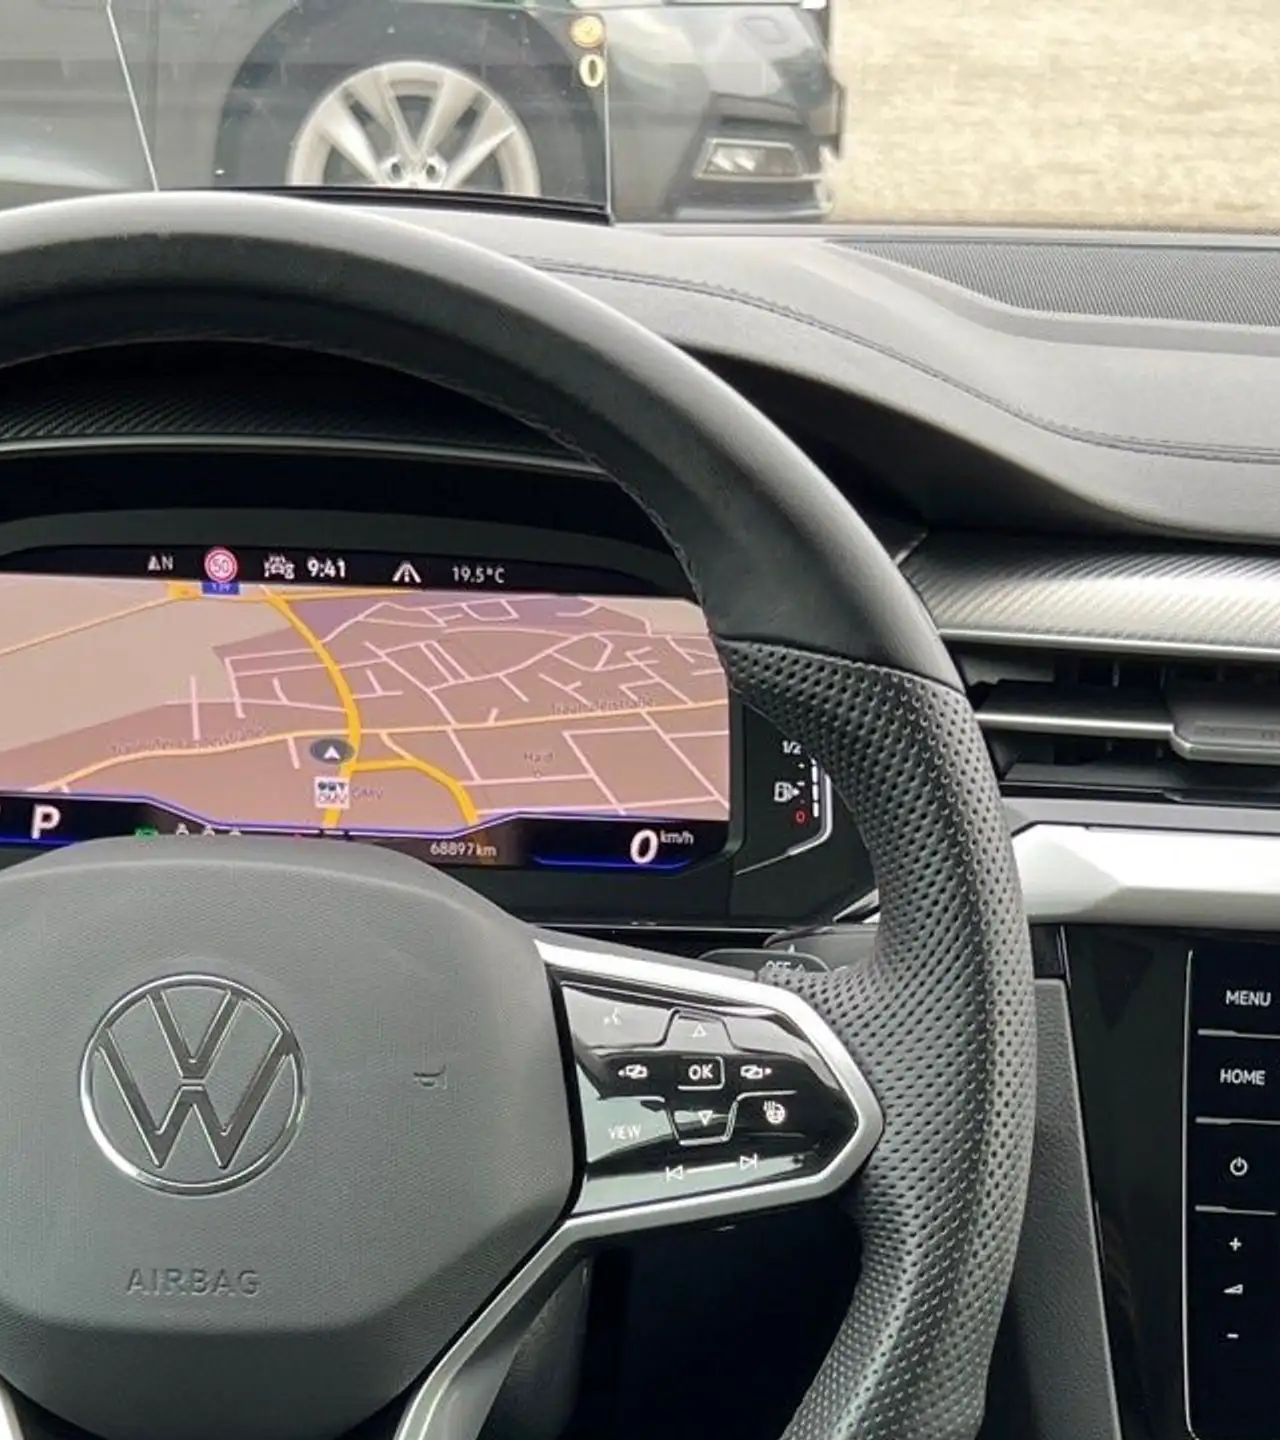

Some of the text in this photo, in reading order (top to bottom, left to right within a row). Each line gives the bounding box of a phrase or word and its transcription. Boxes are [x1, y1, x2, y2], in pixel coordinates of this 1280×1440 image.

[212, 557, 230, 576] 50
[306, 556, 347, 579] 9:41
[452, 565, 505, 583] 19.5°C
[782, 740, 802, 755] 1/2
[31, 803, 61, 840] P
[795, 809, 806, 824] 0
[430, 842, 497, 858] 68897 km
[630, 829, 694, 865] 0 km/h
[1226, 989, 1272, 1007] MENU
[688, 1064, 713, 1080] OK
[1219, 1068, 1266, 1085] HOME
[608, 1123, 642, 1140] VIEW
[125, 1267, 262, 1297] AIRBAG
